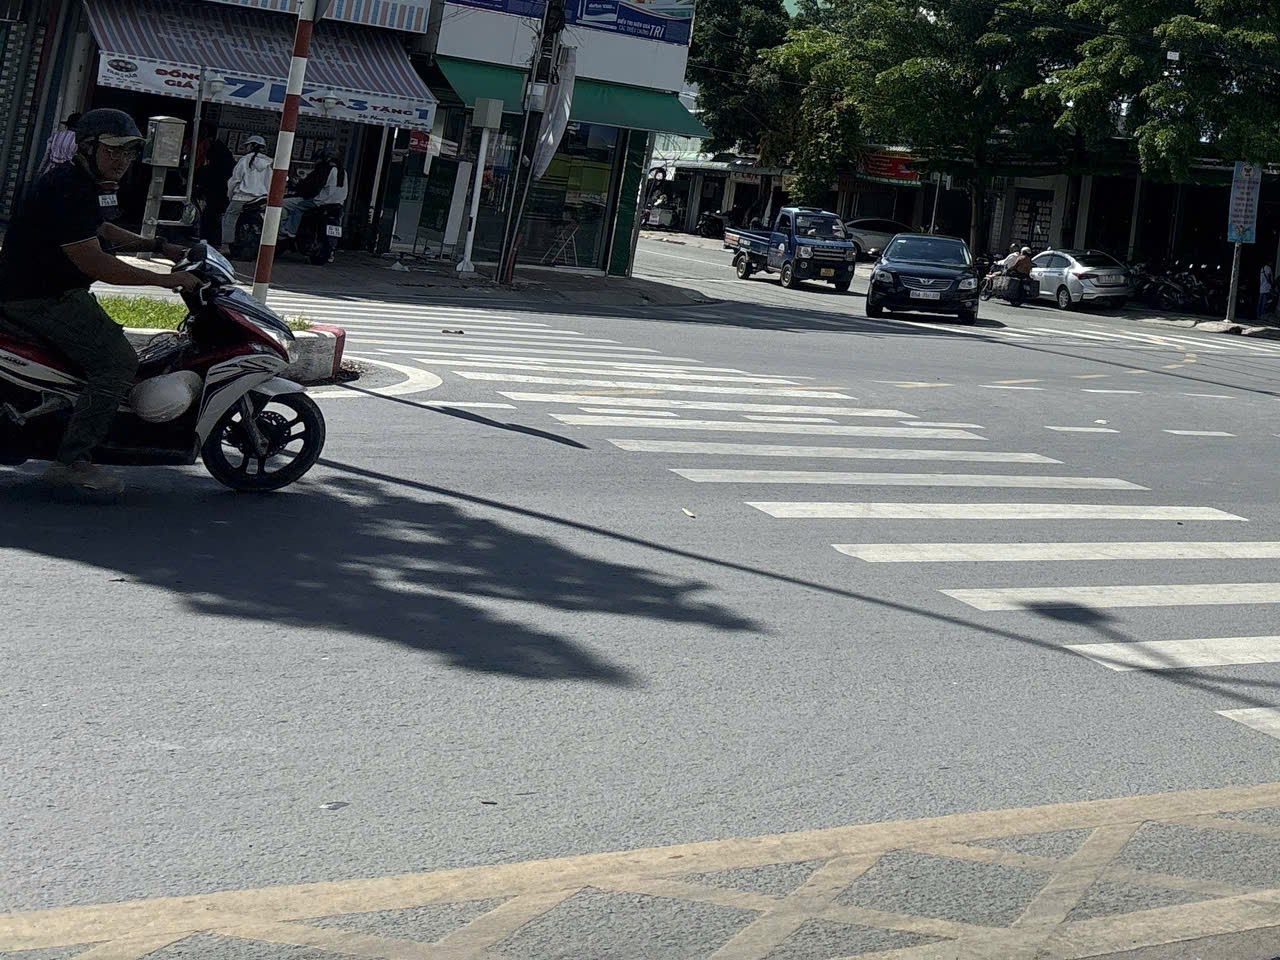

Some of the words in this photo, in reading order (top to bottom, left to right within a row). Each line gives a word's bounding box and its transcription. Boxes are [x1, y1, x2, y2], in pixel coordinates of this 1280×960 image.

[164, 79, 195, 90] GIÁ
[223, 76, 317, 108] 7K
[309, 96, 346, 108] MA
[346, 99, 368, 112] 3
[370, 104, 414, 117] TẶNG
[415, 107, 429, 120] 1
